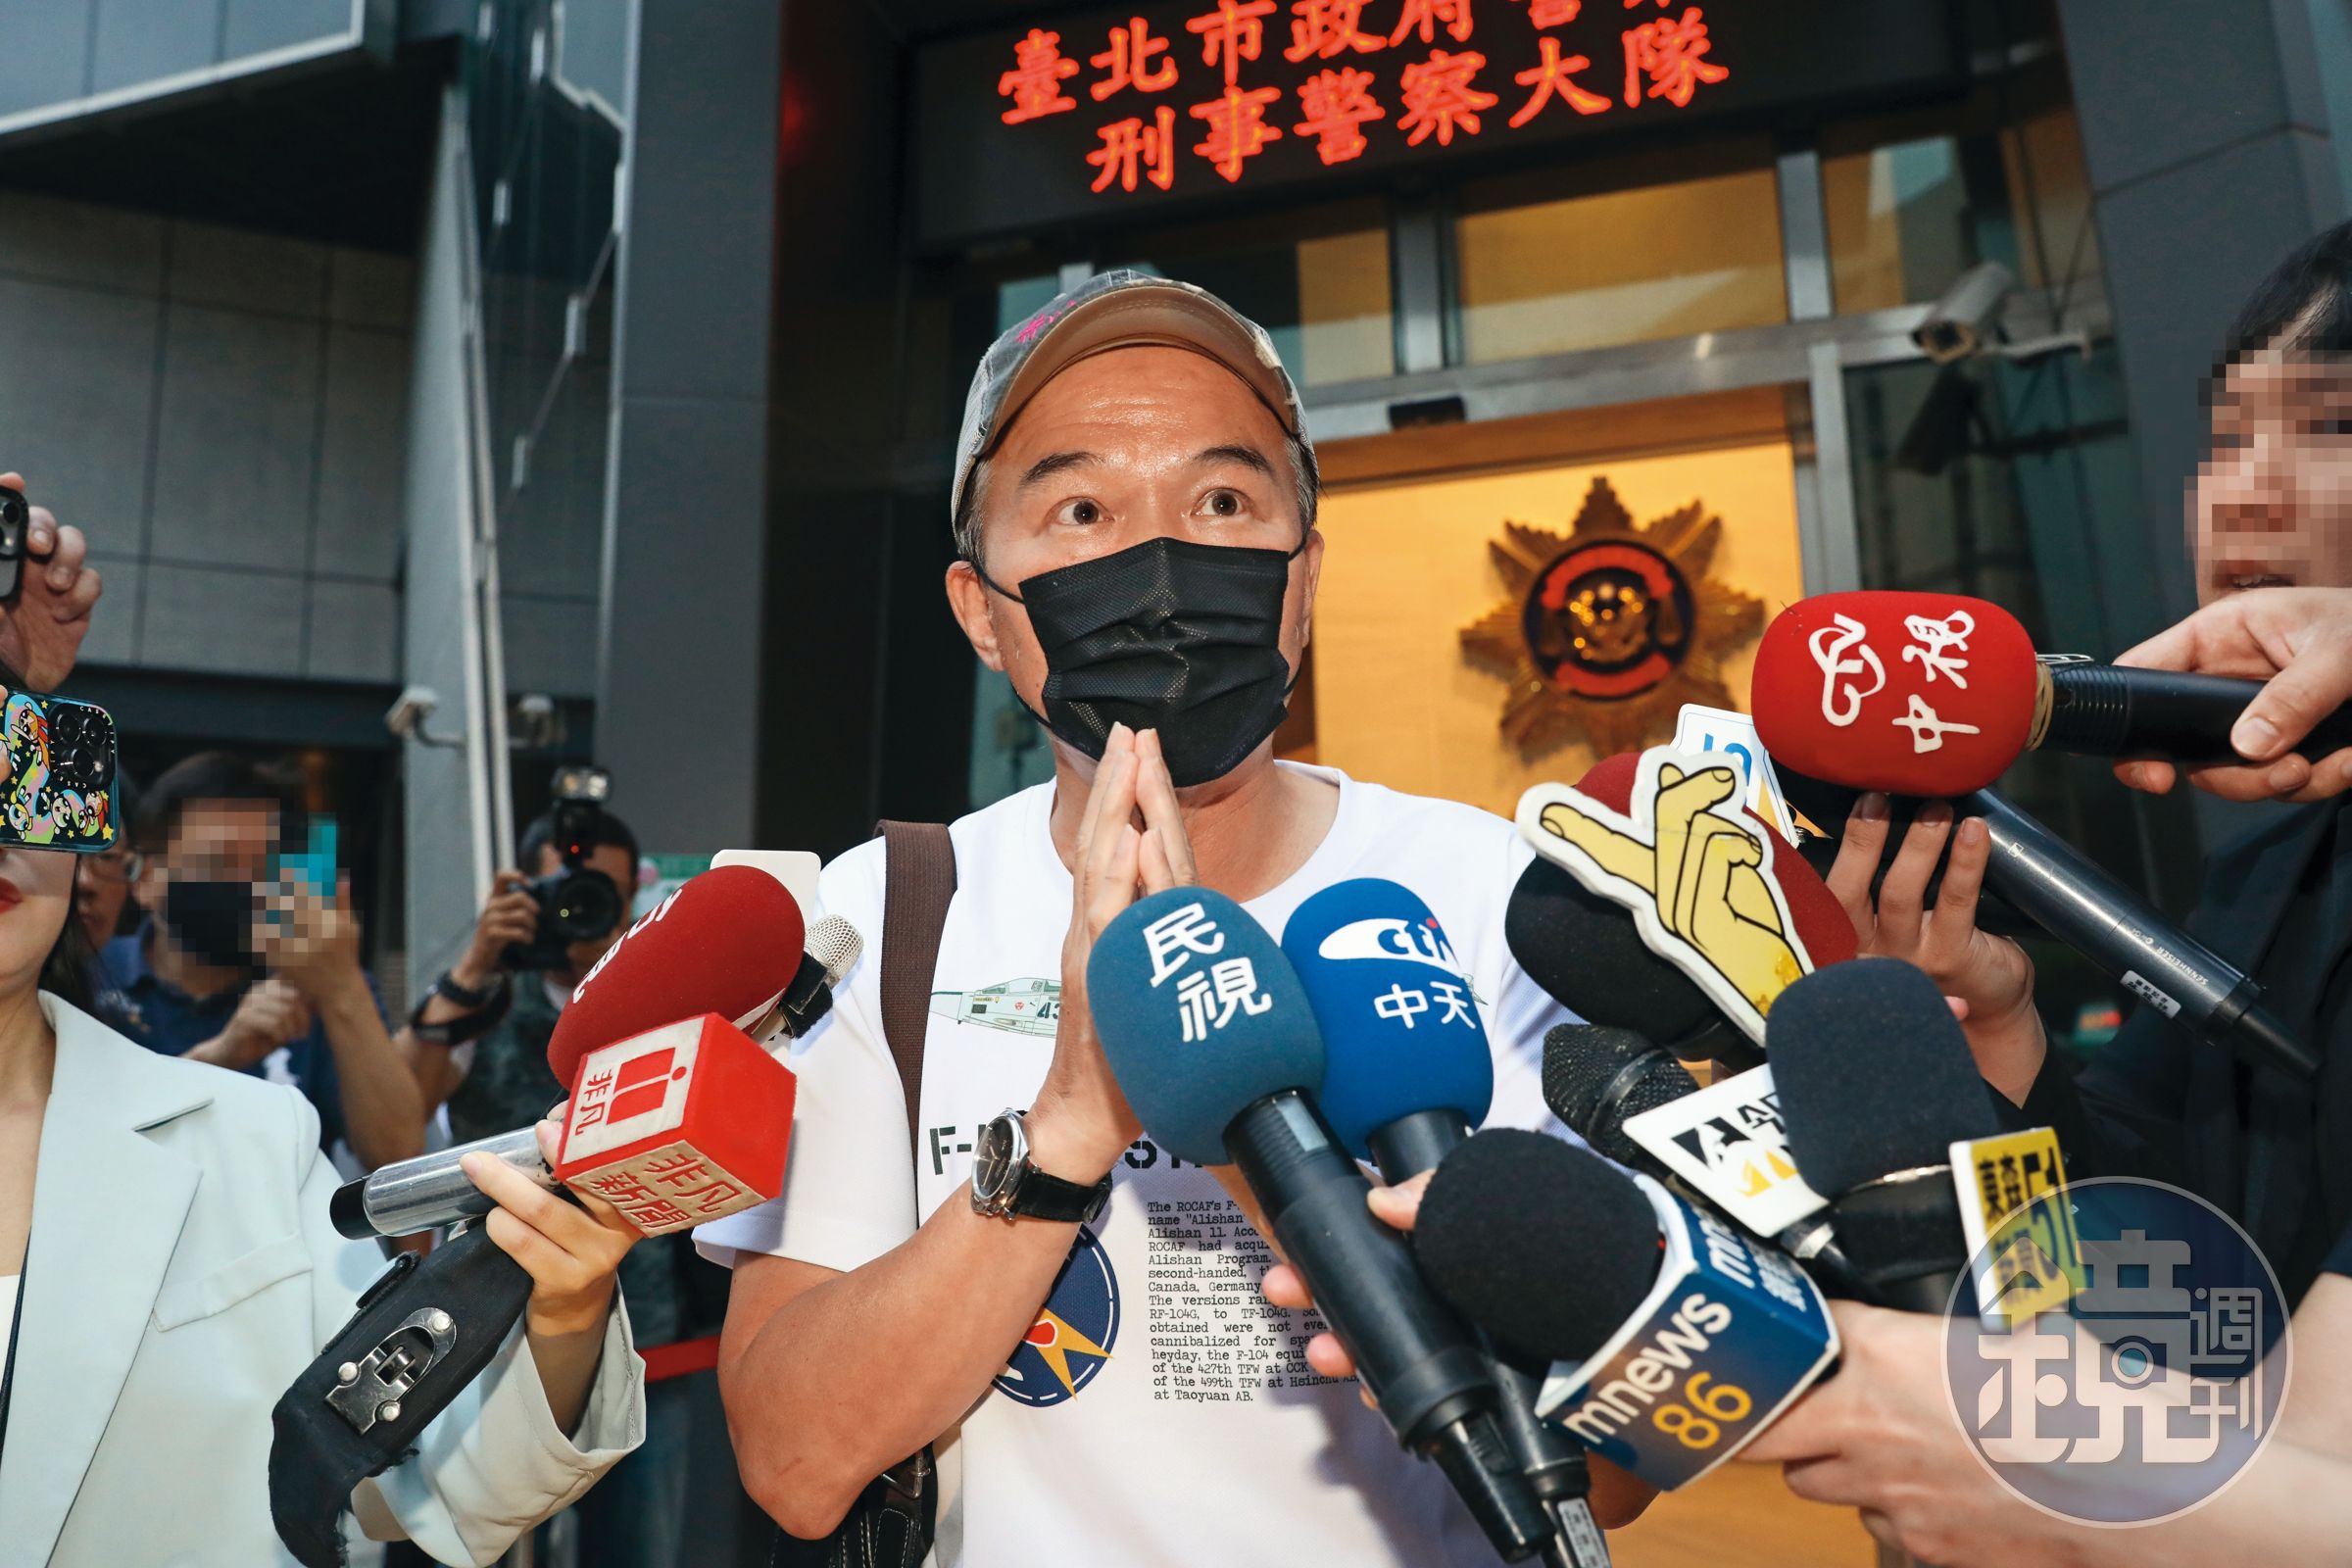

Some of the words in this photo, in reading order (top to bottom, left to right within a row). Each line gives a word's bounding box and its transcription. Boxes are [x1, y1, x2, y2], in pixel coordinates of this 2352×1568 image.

[999, 0, 1671, 124] 臺北市政府
[1087, 7, 1729, 192] 刑事警察大隊
[1891, 610, 1980, 754] 中視
[1143, 903, 1272, 1042] 民視
[2156, 947, 2209, 985] SENNHEISER
[1374, 983, 1476, 1029] 中天
[575, 1069, 612, 1135] 非凡
[643, 1153, 742, 1212] 非凡
[590, 1171, 692, 1228] 新聞
[1148, 1201, 1171, 1212] The
[1177, 1200, 1221, 1211] ROCAF's
[1225, 1200, 1240, 1211] F-
[1148, 1227, 1201, 1239] Alishan
[1149, 1242, 1185, 1251] ROCAF
[1199, 1240, 1221, 1251] had
[1149, 1254, 1202, 1265] Alishan
[1217, 1254, 1271, 1268] Program.
[1149, 1265, 1247, 1278] second-handed,
[1149, 1281, 1200, 1293] Canada,
[1209, 1279, 1261, 1294] Germany
[1149, 1295, 1172, 1305] The
[1181, 1295, 1240, 1305] versions
[1150, 1308, 1200, 1320] RF-104G,
[1213, 1308, 1227, 1319] to
[1242, 1307, 1291, 1319] TF-104G.
[1150, 1321, 1209, 1333] obtained
[1224, 1324, 1253, 1333] were
[1268, 1321, 1291, 1332] not
[1151, 1335, 1241, 1347] cannibalized
[1254, 1335, 1276, 1347] for
[1289, 1334, 1314, 1348] spa
[1152, 1348, 1200, 1363] heyday,
[1207, 1349, 1229, 1360] the
[1236, 1349, 1269, 1360] F-104
[1274, 1347, 1306, 1362] equi
[1152, 1362, 1166, 1373] of
[1170, 1361, 1195, 1374] the
[1198, 1363, 1232, 1374] 427th
[1238, 1364, 1259, 1374] TFW
[1265, 1362, 1281, 1374] at
[1287, 1361, 1309, 1373] CCK
[1563, 1294, 1732, 1444] mnews
[1153, 1375, 1167, 1386] of
[1173, 1376, 1196, 1387] the
[1200, 1377, 1233, 1388] 499th
[1239, 1378, 1261, 1388] TFW
[1268, 1376, 1284, 1388] at
[1154, 1389, 1170, 1399] at
[1175, 1390, 1230, 1402] Taoyuan
[1235, 1391, 1253, 1401] AB.
[1652, 1372, 1752, 1449] 86
